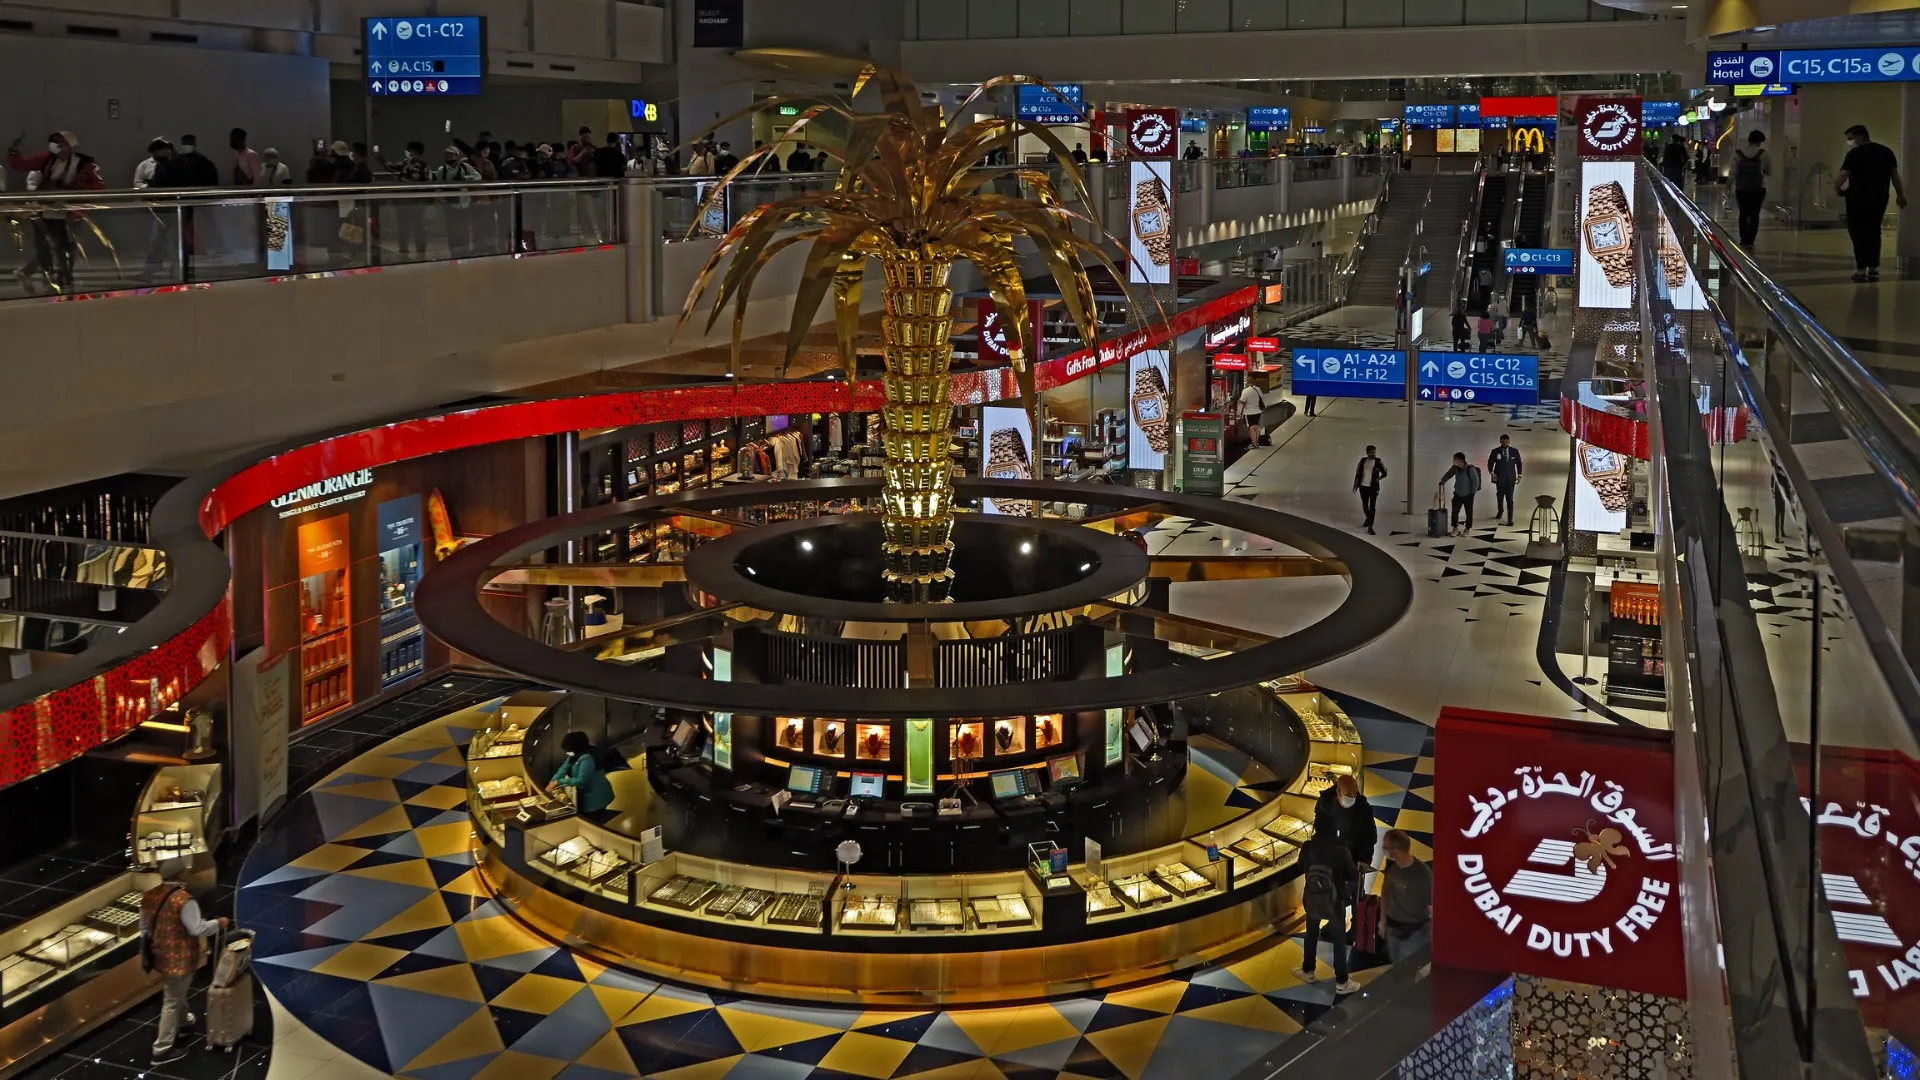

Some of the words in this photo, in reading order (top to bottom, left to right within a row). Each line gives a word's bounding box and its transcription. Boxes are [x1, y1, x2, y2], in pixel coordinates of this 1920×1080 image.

[1713, 56, 1744, 68] الفندق
[1788, 59, 1825, 76] C15,
[1827, 58, 1872, 74] C15a
[1713, 69, 1744, 79] Hotel
[1131, 133, 1144, 151] DUBAI
[1144, 145, 1161, 153] DUTY
[1160, 133, 1172, 148] FREE
[1583, 128, 1600, 148] DUBAI
[1600, 141, 1623, 151] DUTY
[1622, 127, 1637, 145] FREE
[1531, 254, 1561, 262] C1-C13
[983, 330, 1000, 352] DUBAI
[1066, 358, 1082, 376] Gifts
[1343, 353, 1397, 366] A1-A24
[1469, 358, 1521, 371] C1-C12
[1343, 369, 1388, 380] F1-F12
[1469, 372, 1498, 386] C15,
[1499, 373, 1534, 386] C15a
[279, 507, 302, 519] SINGLE
[302, 502, 319, 513] MALT
[319, 496, 344, 508] SCOTCH
[1590, 780, 1675, 861] السوق
[1457, 854, 1524, 936] DUBAI
[1526, 923, 1615, 958] DUTY
[1615, 876, 1671, 944] FREE
